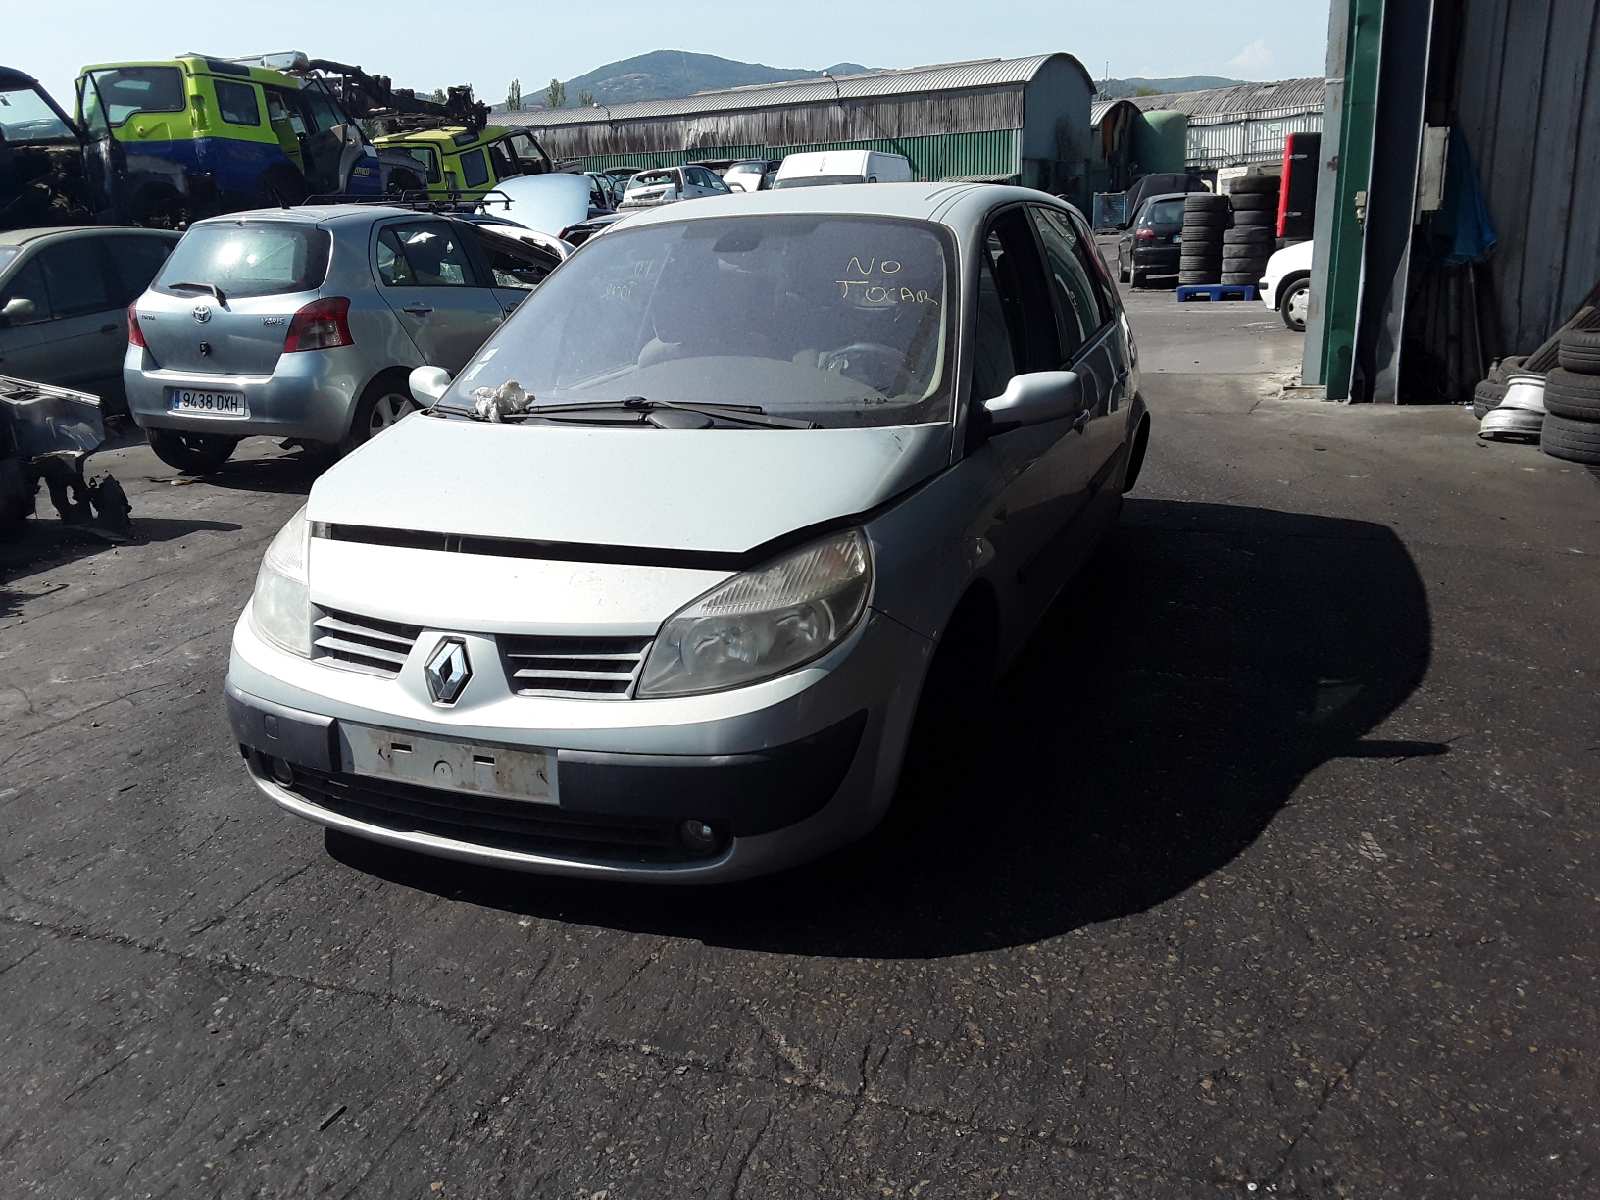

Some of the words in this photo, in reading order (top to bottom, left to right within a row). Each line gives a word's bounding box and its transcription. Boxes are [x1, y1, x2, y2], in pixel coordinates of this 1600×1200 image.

[846, 256, 901, 275] NO
[835, 280, 938, 305] TOCAR
[183, 392, 213, 410] 9438
[217, 394, 238, 413] DXH
